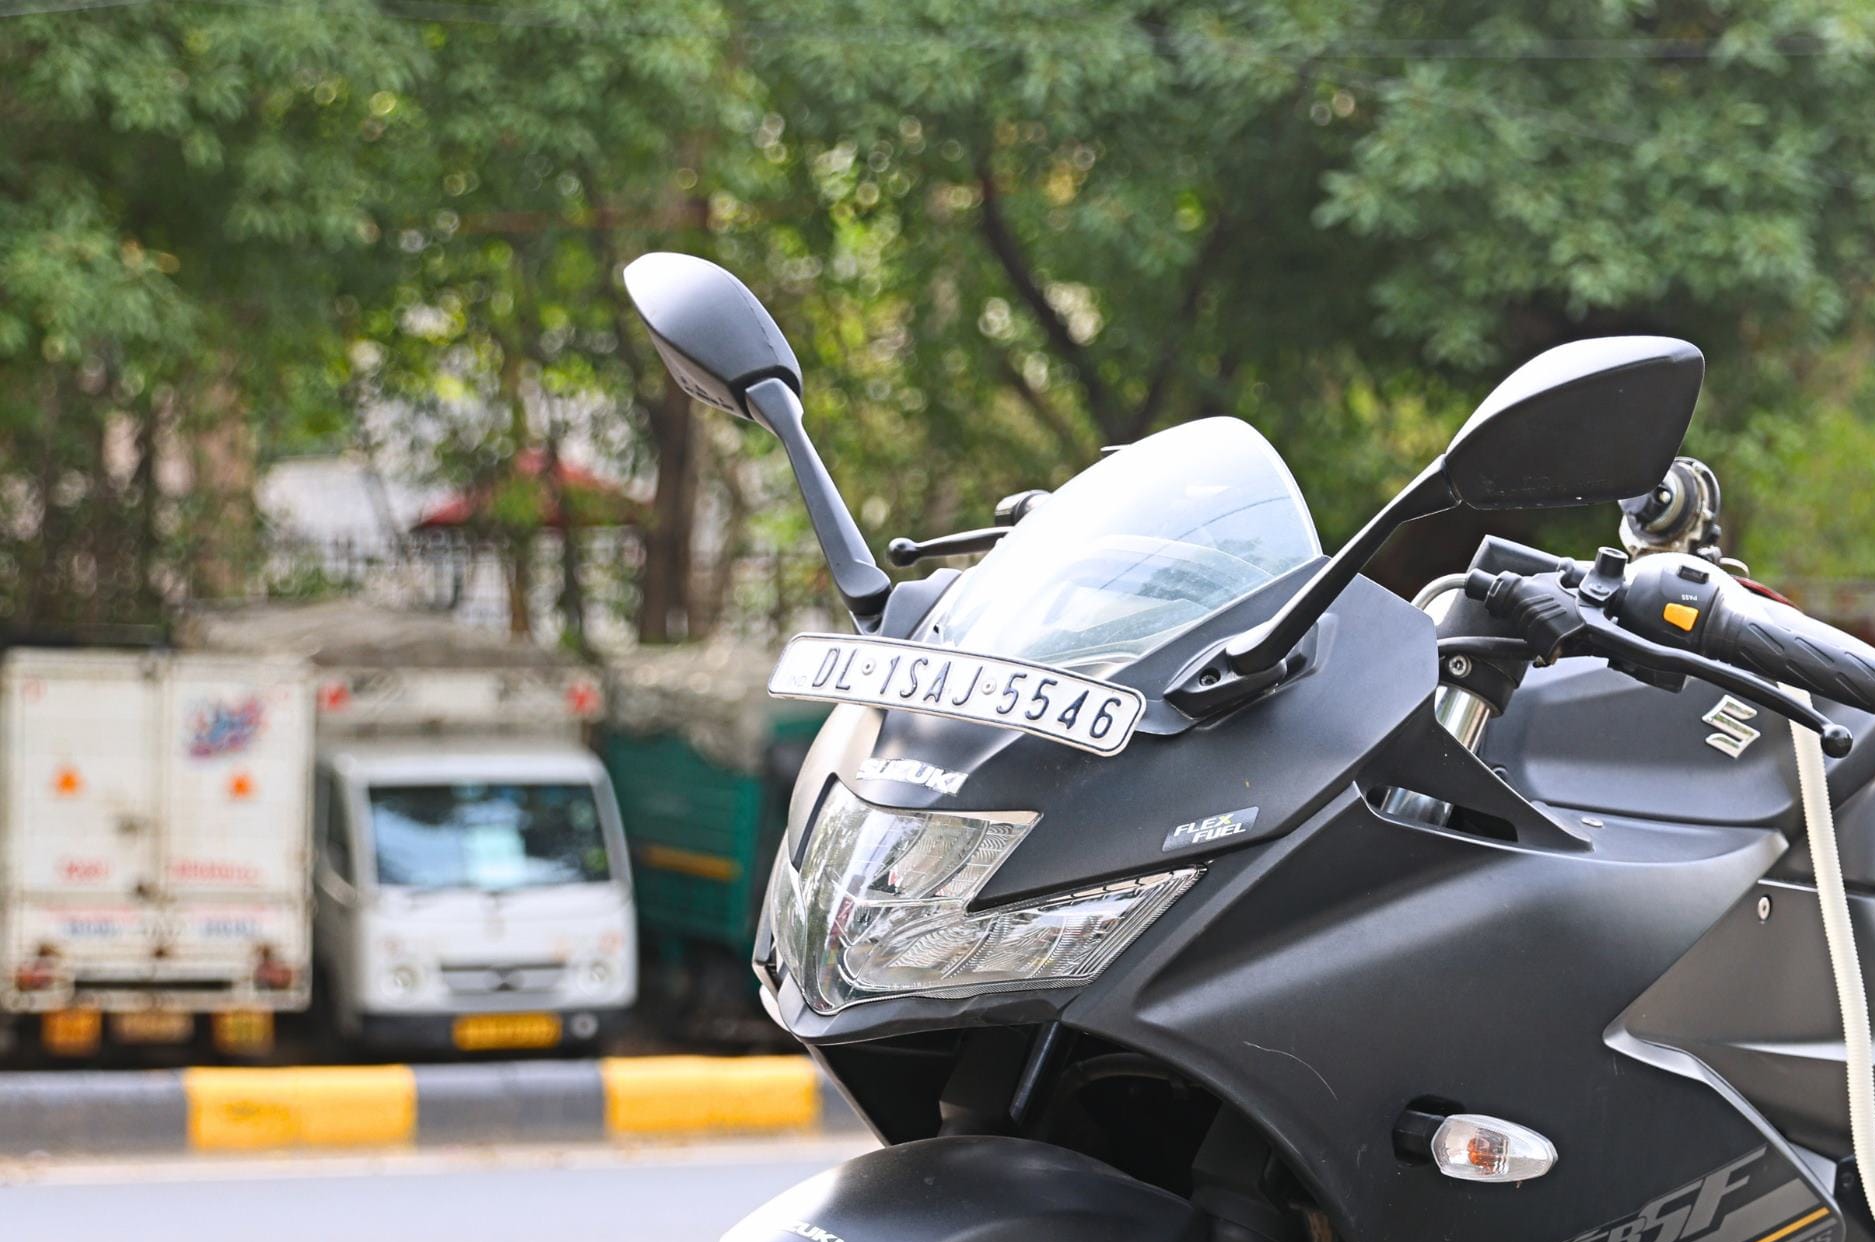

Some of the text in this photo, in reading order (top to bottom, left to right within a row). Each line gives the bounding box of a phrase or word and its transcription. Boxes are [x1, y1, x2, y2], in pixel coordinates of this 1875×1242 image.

[811, 648, 1122, 739] DL 1SAJ 5546
[1173, 813, 1234, 837] FLEX
[1192, 822, 1246, 843] FUEL
